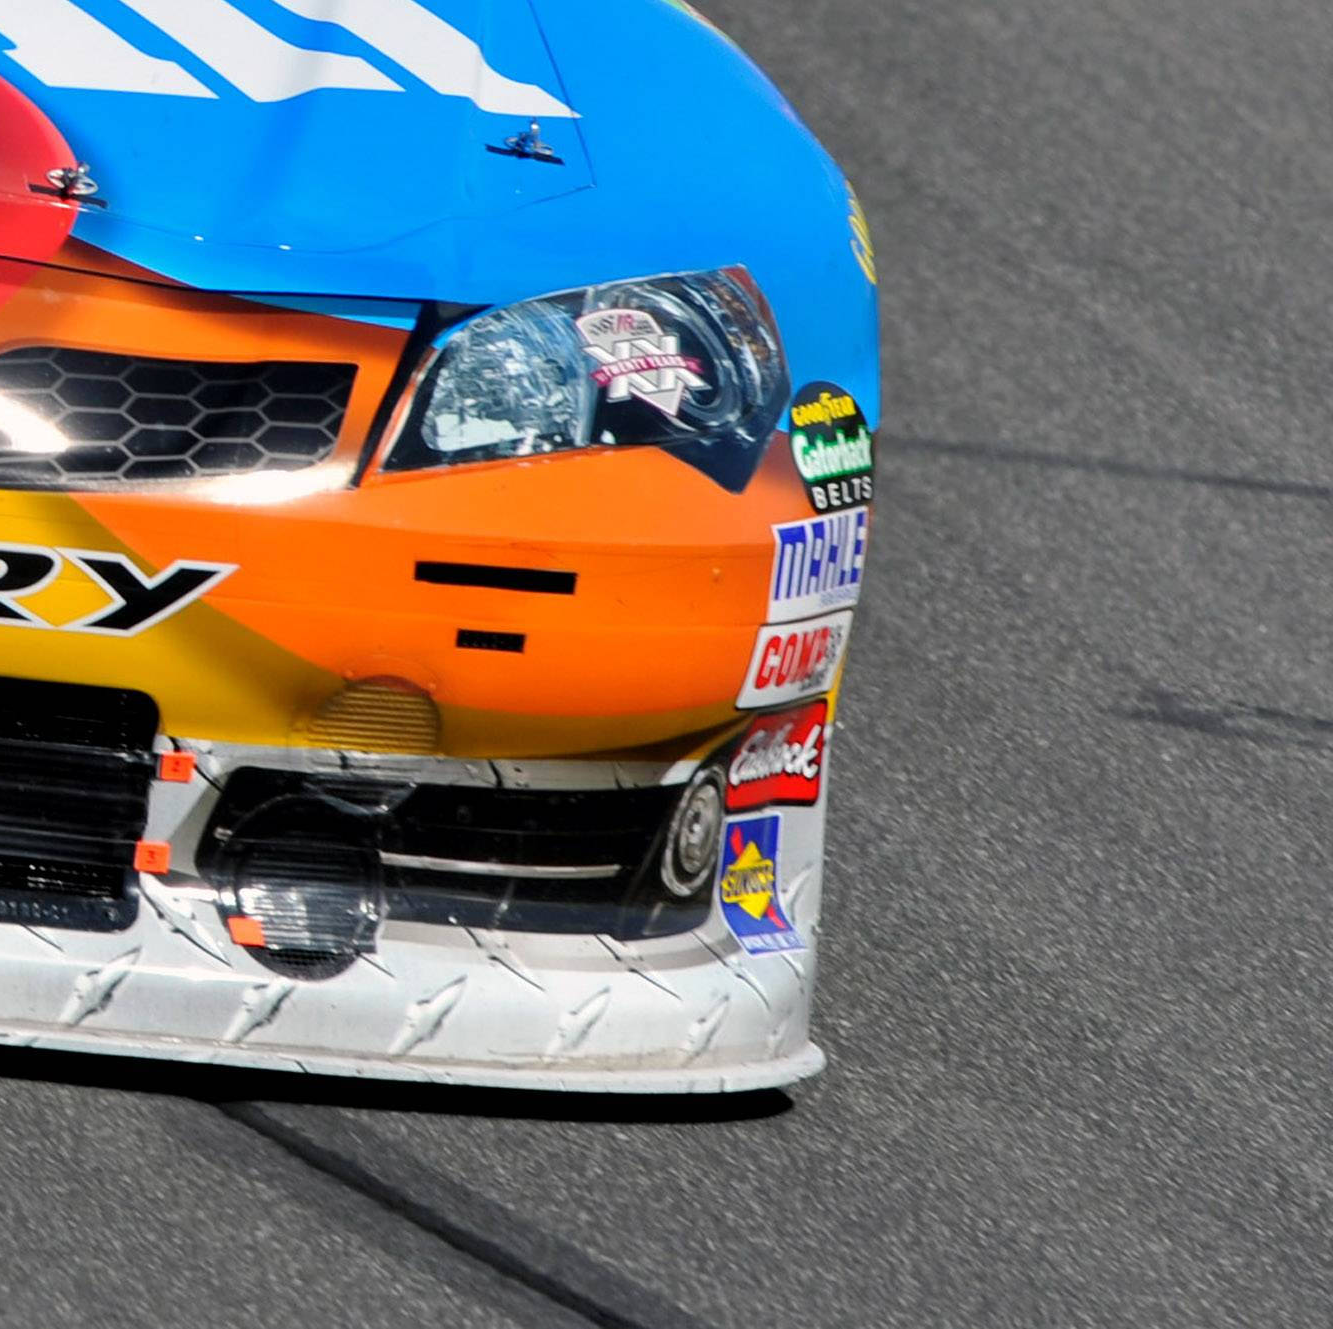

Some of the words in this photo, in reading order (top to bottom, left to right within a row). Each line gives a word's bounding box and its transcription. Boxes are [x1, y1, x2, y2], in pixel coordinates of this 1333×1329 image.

[811, 475, 873, 510] BELTS
[774, 512, 866, 601] MAHLE
[754, 626, 831, 690] COMP
